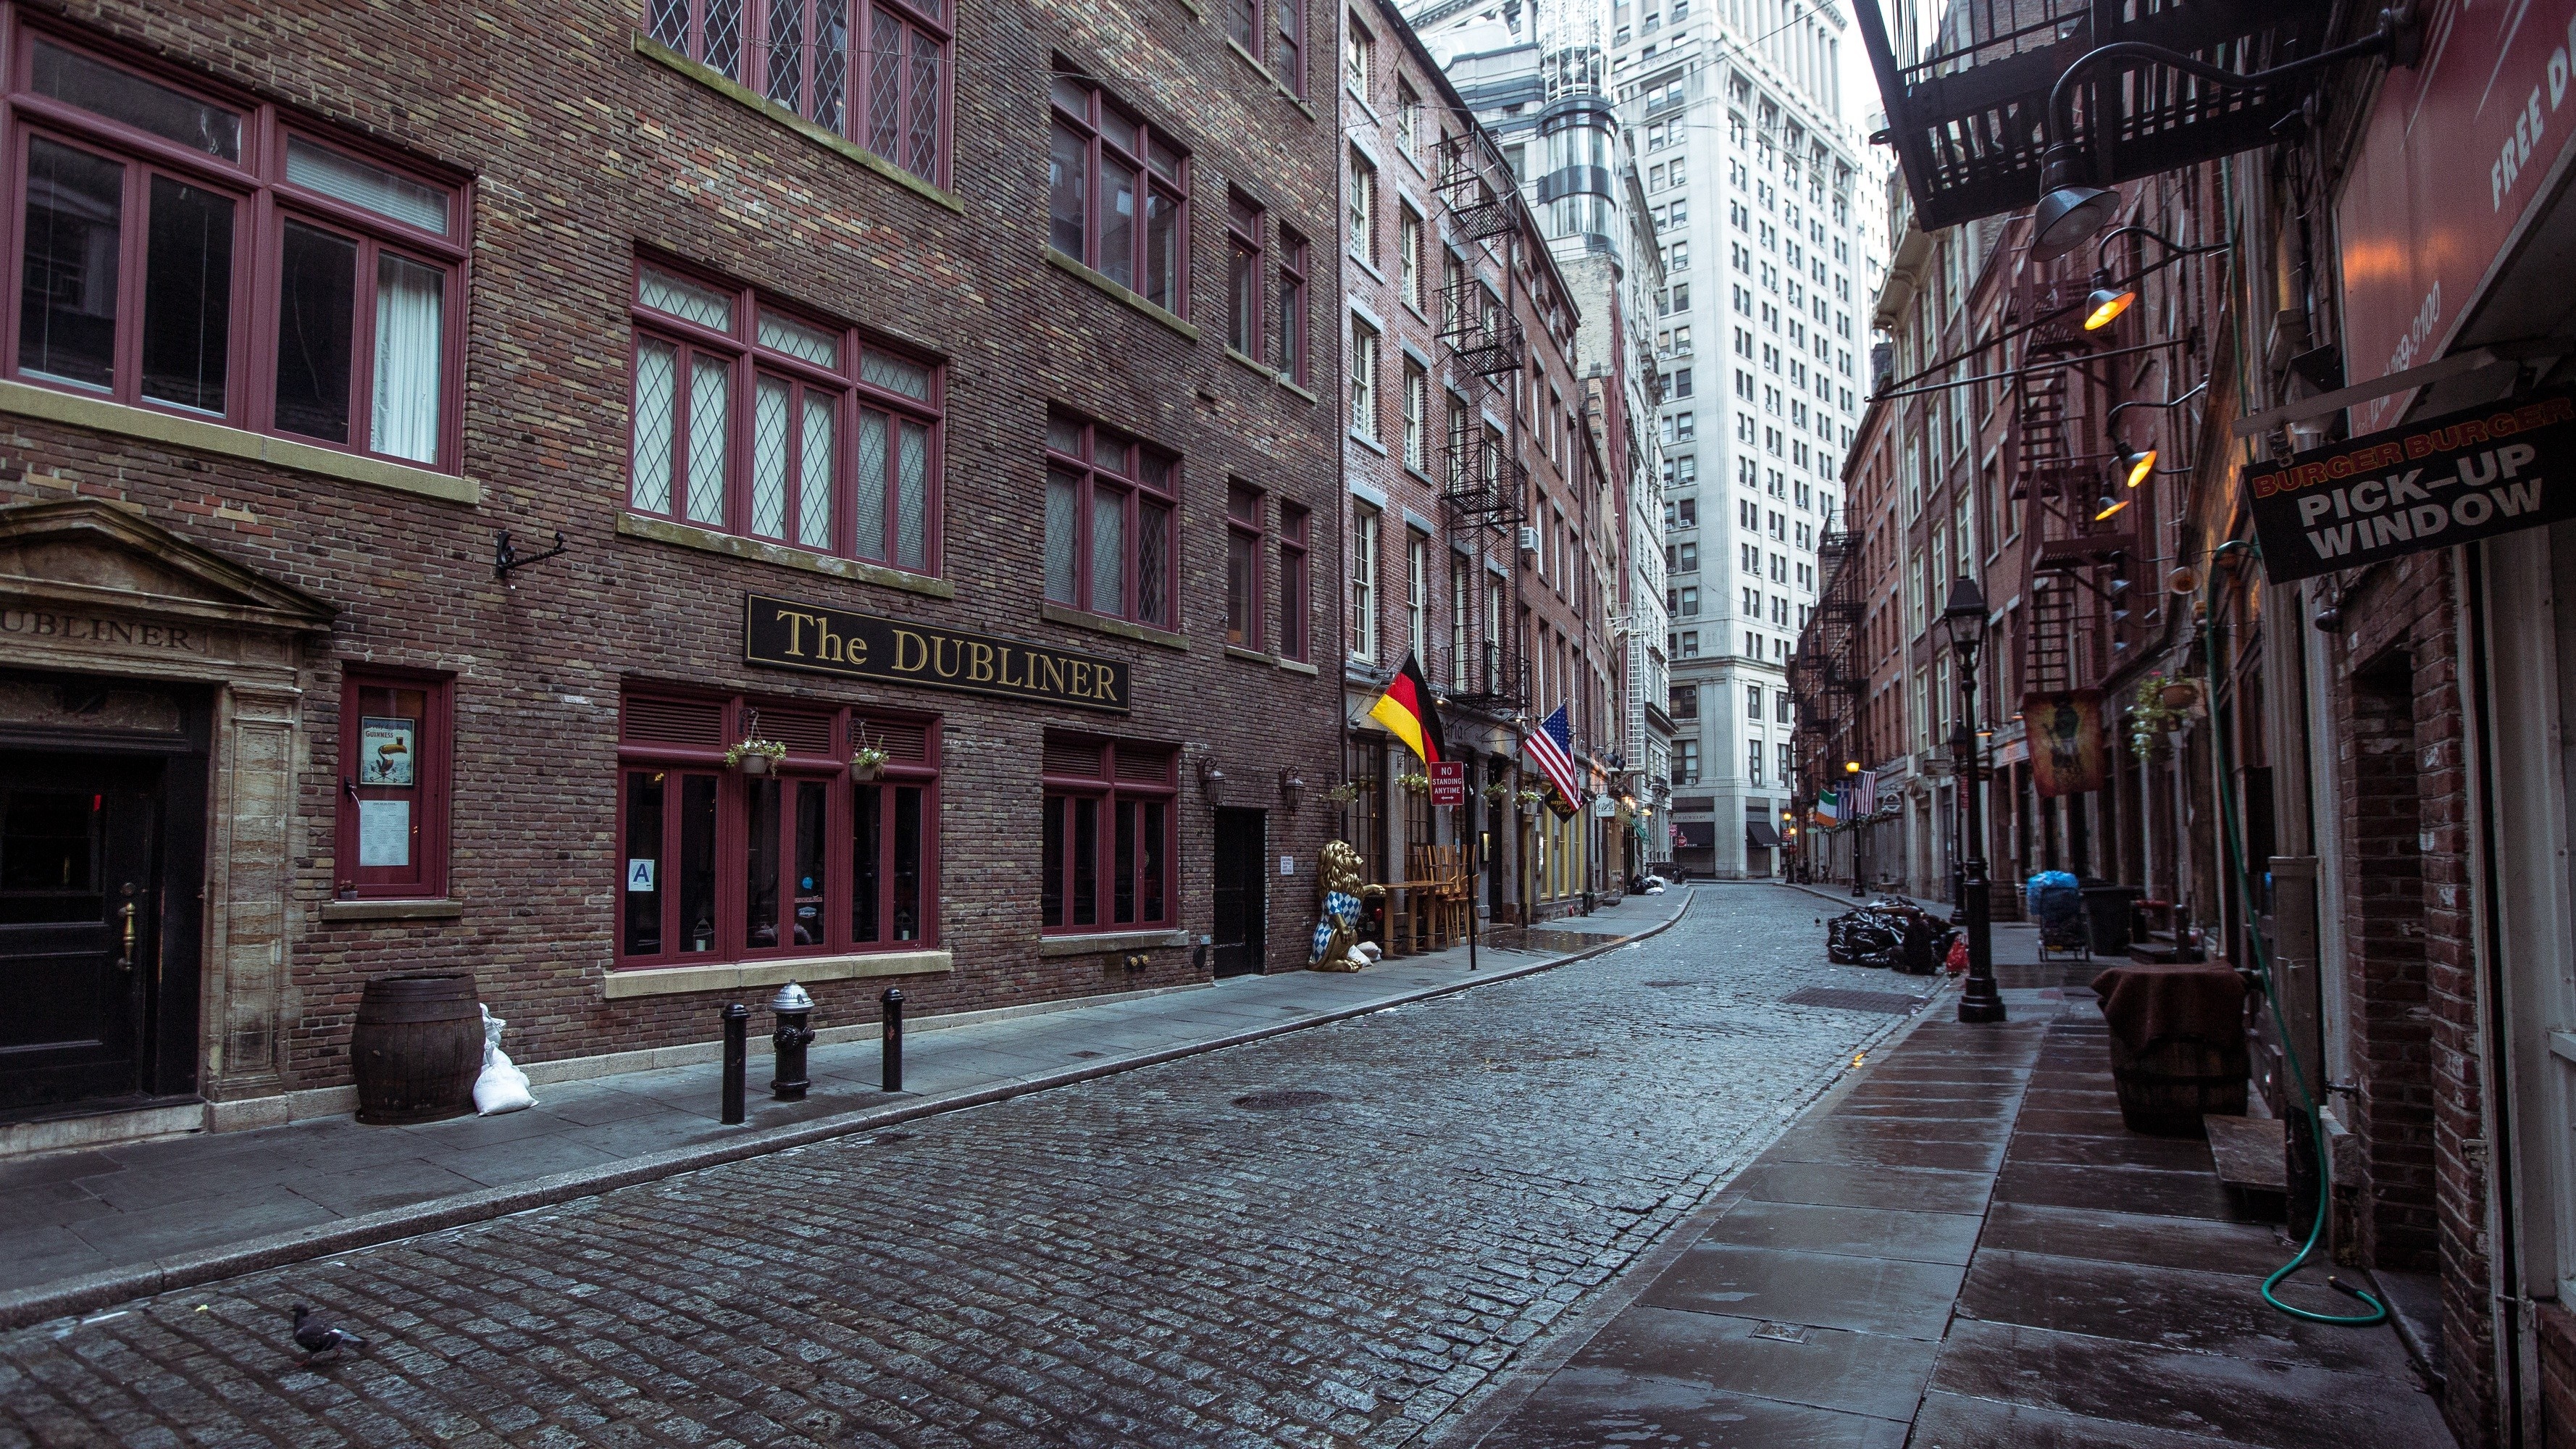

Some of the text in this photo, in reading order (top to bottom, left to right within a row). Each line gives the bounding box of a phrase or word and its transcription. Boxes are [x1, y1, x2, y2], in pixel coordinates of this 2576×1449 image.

[2491, 84, 2544, 213] FREE
[2252, 397, 2576, 499] BURGER BURGER
[2297, 443, 2535, 527] PICK-UP
[2306, 478, 2543, 560] WINDOW
[0, 609, 193, 650] UBLINER
[776, 610, 1118, 701] The DUBLINER
[1441, 722, 1463, 741] aria
[1441, 767, 1452, 775] NO
[633, 864, 650, 882] A
